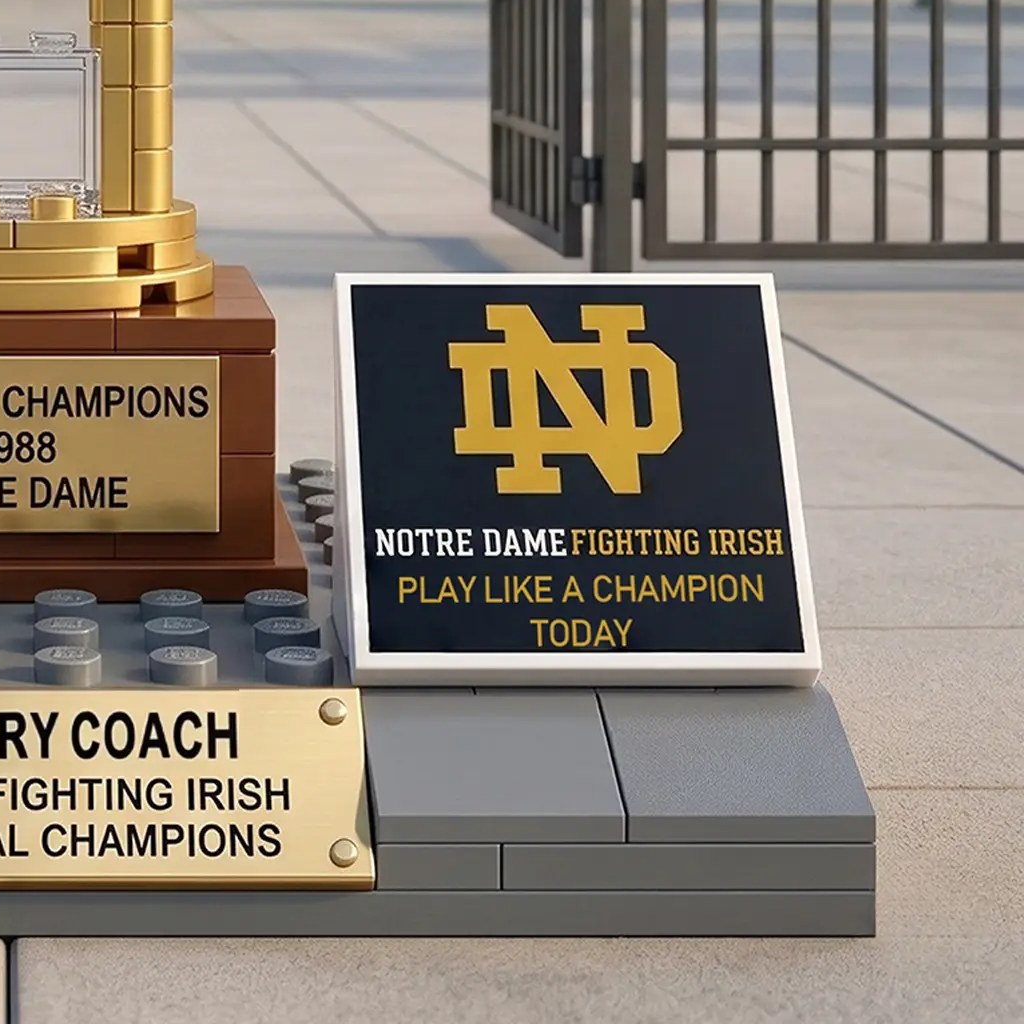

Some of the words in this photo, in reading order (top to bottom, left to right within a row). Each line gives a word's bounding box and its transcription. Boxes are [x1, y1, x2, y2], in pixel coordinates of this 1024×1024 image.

[2, 385, 210, 419] CHAMPIONS
[30, 476, 129, 509] DAME
[375, 528, 474, 557] NOTRE
[484, 528, 567, 557] DAME
[571, 528, 700, 557] FIGHTING
[709, 528, 784, 557] IRISH
[399, 576, 477, 603] PLAY
[484, 575, 553, 603] LIKE
[562, 575, 585, 603] A
[592, 574, 764, 603] CHAMPION
[530, 618, 633, 647] TODAY
[74, 710, 240, 760] COACH
[186, 777, 290, 811] IRISH
[40, 823, 283, 857] CHAMPIONS
